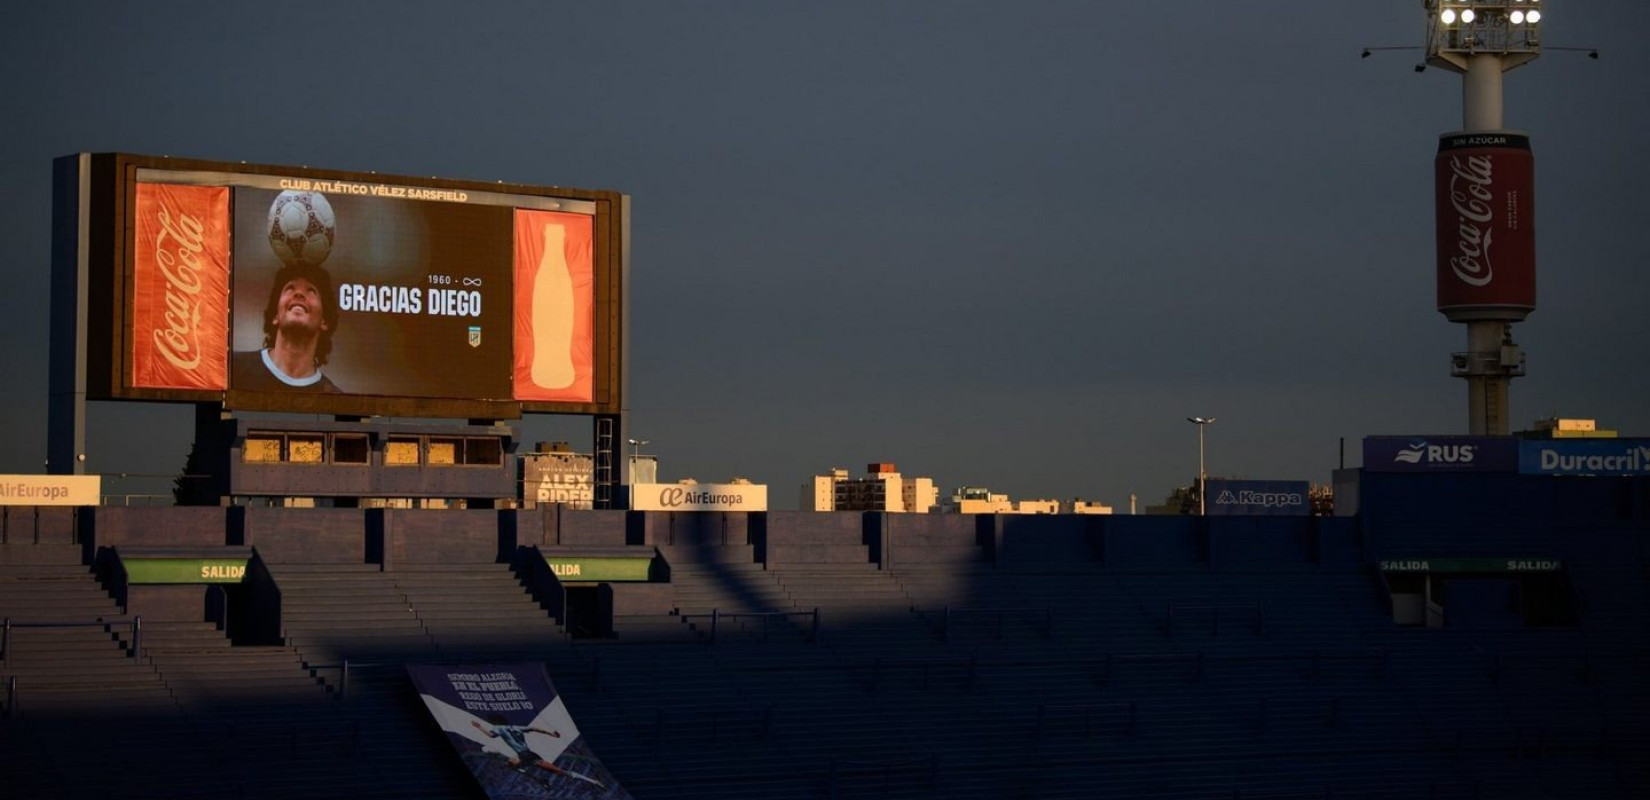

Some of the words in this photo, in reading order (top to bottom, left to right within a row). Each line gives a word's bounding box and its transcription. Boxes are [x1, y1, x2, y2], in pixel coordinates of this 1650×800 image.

[1468, 136, 1507, 145] AZÚCAR
[280, 179, 311, 190] CLUB
[313, 181, 366, 194] ATLÉTICO
[370, 184, 406, 198] VÉLEZ
[407, 188, 468, 202] SARSFIELD
[428, 275, 451, 285] 1960
[339, 283, 422, 314] GRACIAS
[428, 288, 481, 317] DIEGO
[1428, 445, 1474, 463] RUS
[1540, 448, 1640, 471] Duracril
[539, 473, 589, 490] ALEX
[537, 489, 593, 504] RIDER
[684, 491, 743, 507] AirEuropa
[1239, 490, 1302, 508] Kappa
[201, 565, 246, 578] SALIDA
[549, 564, 581, 576] ALIDA
[1379, 560, 1430, 571] SALIDA
[464, 700, 490, 711] ESTE
[490, 701, 521, 711] SUELO
